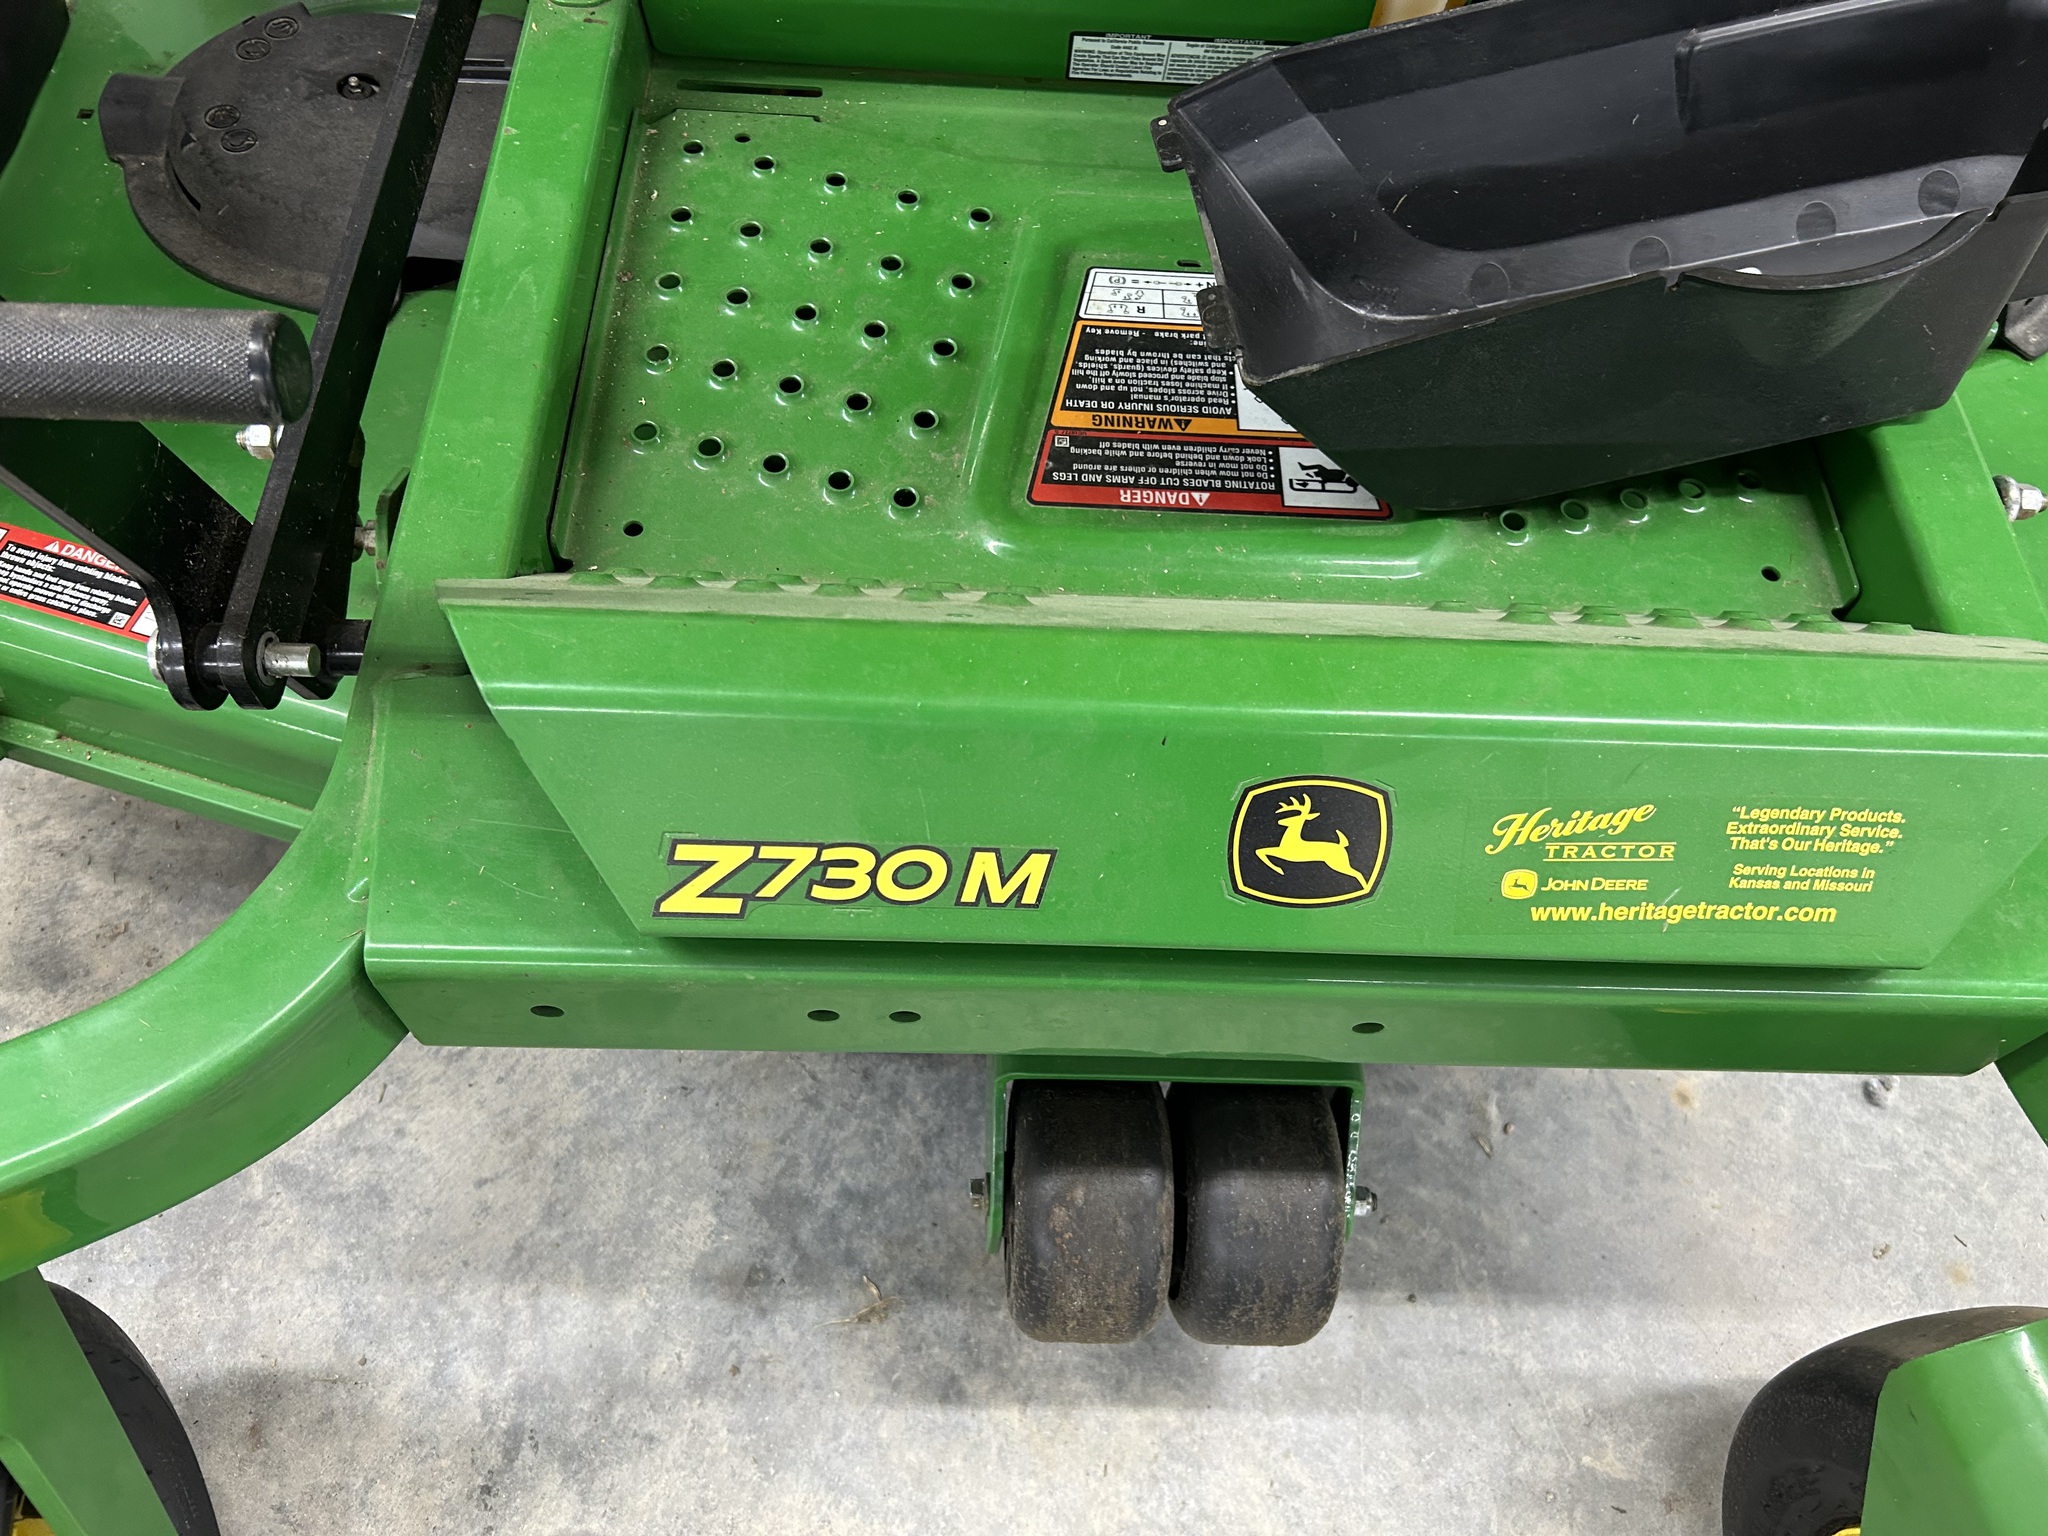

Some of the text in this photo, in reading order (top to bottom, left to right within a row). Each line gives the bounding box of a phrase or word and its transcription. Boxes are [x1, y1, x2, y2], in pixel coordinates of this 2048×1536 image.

[1137, 306, 1145, 314] R
[1086, 326, 1101, 335] Key
[1104, 329, 1140, 337] Remove
[1154, 331, 1178, 339] brake
[1095, 349, 1124, 357] blades
[1127, 348, 1137, 357] by
[1140, 351, 1170, 359] thrown
[1084, 354, 1116, 363] working
[1075, 361, 1108, 369] shields,
[1110, 363, 1144, 372] (guards,
[1170, 359, 1209, 368] switches)
[1146, 365, 1178, 373] devices
[1112, 370, 1136, 378] slowly
[1138, 372, 1169, 380] proceed
[1089, 376, 1106, 384] hill,
[1128, 379, 1159, 387] traction
[1076, 383, 1098, 391] down
[1185, 382, 1220, 390] machine
[1131, 393, 1229, 405] Read operator's manual
[1066, 399, 1232, 415] AVOID SERIOUS INJURY OR DEATH
[1092, 414, 1173, 430] WARNING
[1099, 441, 1110, 449] off
[1113, 442, 1140, 450] blades
[1142, 443, 1159, 451] with
[1183, 445, 1217, 453] children
[1070, 446, 1102, 456] backing
[1104, 449, 1127, 457] while
[1129, 450, 1144, 458] and
[1147, 451, 1173, 459] before
[1242, 448, 1266, 456] Never
[1175, 452, 1203, 460] behind
[1223, 455, 1245, 463] down
[1073, 463, 1101, 472] around
[1120, 465, 1146, 473] others
[1159, 467, 1192, 476] children
[1052, 472, 1275, 490] ROTATING BLADES CUT OFF ARMS AND LEGS
[1120, 490, 1189, 505] DANGER
[60, 544, 125, 572] DANGE
[6, 543, 15, 552] To
[15, 547, 38, 558] avoid
[36, 553, 58, 565] injury
[57, 559, 76, 569] from
[75, 565, 105, 579] rotating
[103, 572, 129, 585] blades
[25, 559, 56, 572] objects:
[74, 583, 91, 593] from
[89, 588, 116, 601] rotating
[79, 600, 112, 614] discharge
[1829, 807, 1906, 823] Products.
[1484, 804, 1657, 855] Heritage
[1726, 821, 1903, 839] Extraordinary Service.
[1729, 837, 1778, 851] That's
[1781, 838, 1812, 851] Our
[1545, 845, 1676, 859] TRACTOR
[1733, 863, 1875, 879] Serving Locations in
[652, 839, 1058, 919] Z730 M
[1541, 877, 1649, 891] JOHN DEERE
[1728, 877, 1873, 892] Kansas and Missouri
[1530, 902, 1837, 925] www.heritagetractor.com
